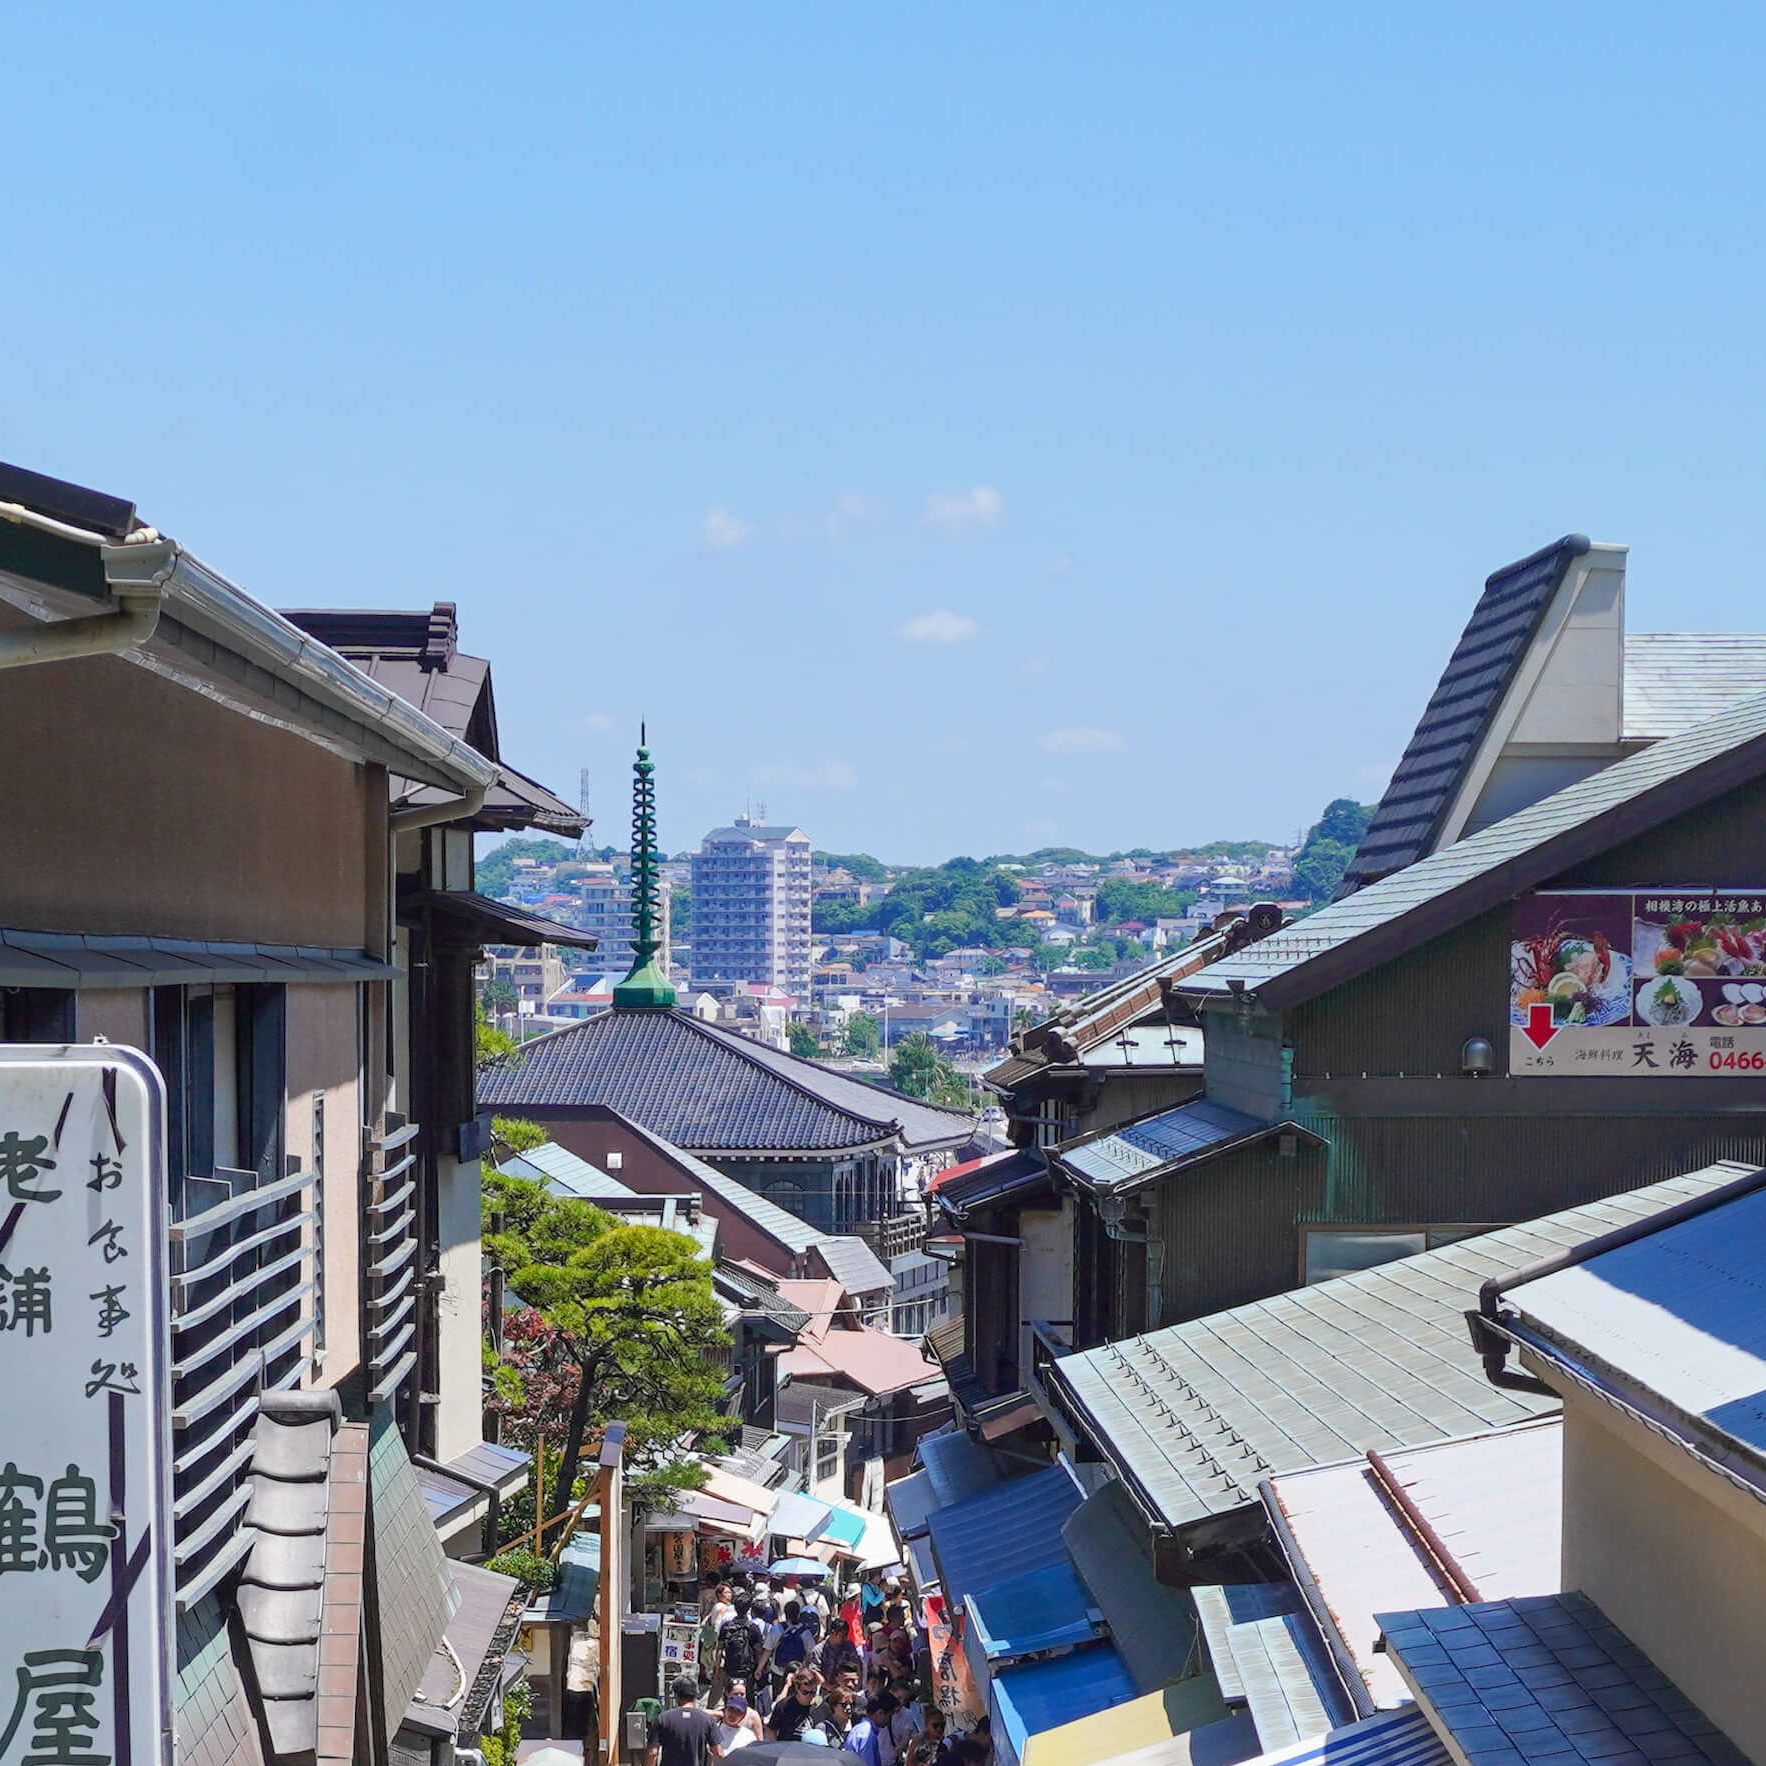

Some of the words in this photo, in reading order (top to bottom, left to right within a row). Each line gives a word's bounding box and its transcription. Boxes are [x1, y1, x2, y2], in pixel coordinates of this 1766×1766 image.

[1709, 1036, 1735, 1049] 電話
[1524, 1056, 1555, 1067] こちら
[1575, 1048, 1624, 1062] 海鮮料理
[1631, 1040, 1699, 1070] 天海
[85, 1151, 142, 1399] お食事処
